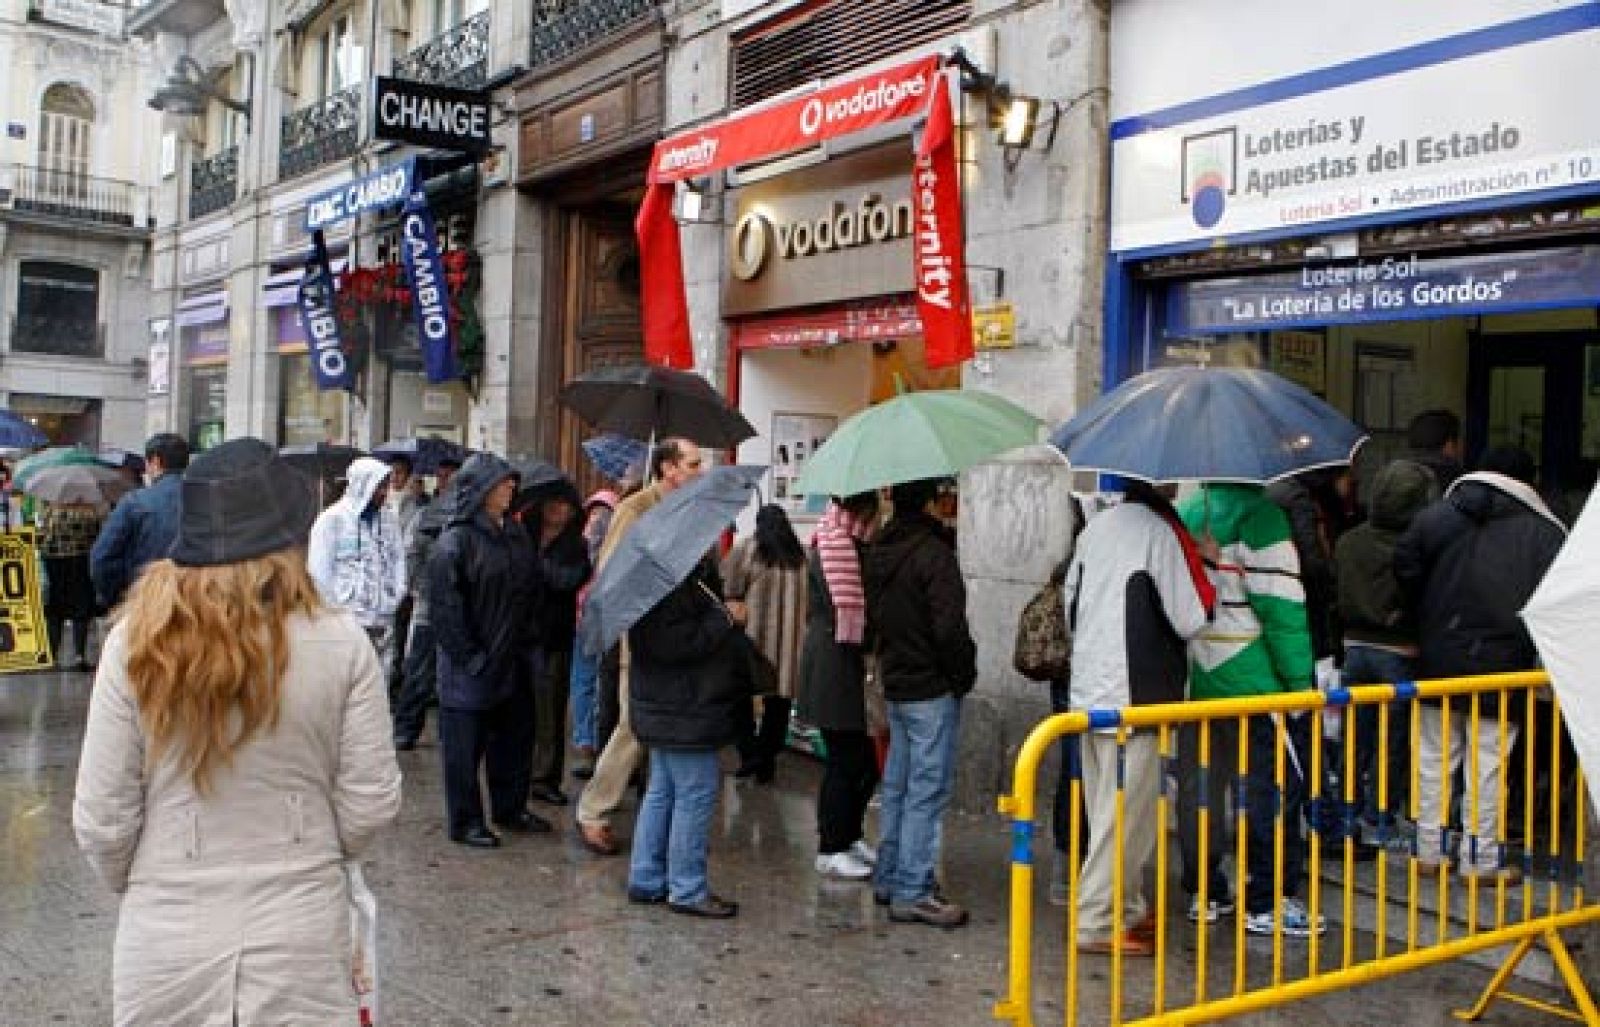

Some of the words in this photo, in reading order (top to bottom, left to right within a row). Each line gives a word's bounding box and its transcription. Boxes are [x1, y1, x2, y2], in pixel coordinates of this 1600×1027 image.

[380, 92, 487, 138] CHANGE
[1244, 118, 1343, 158] Loterías
[1350, 115, 1365, 144] y
[1244, 155, 1357, 198] Apuestas
[1366, 139, 1408, 173] del
[1416, 121, 1520, 164] Estado
[1567, 156, 1594, 179] 10
[775, 193, 915, 258] vodafon
[404, 214, 446, 338] CAMBIO
[1381, 253, 1418, 279] Sol
[1338, 286, 1366, 312] de
[1372, 284, 1405, 309] los
